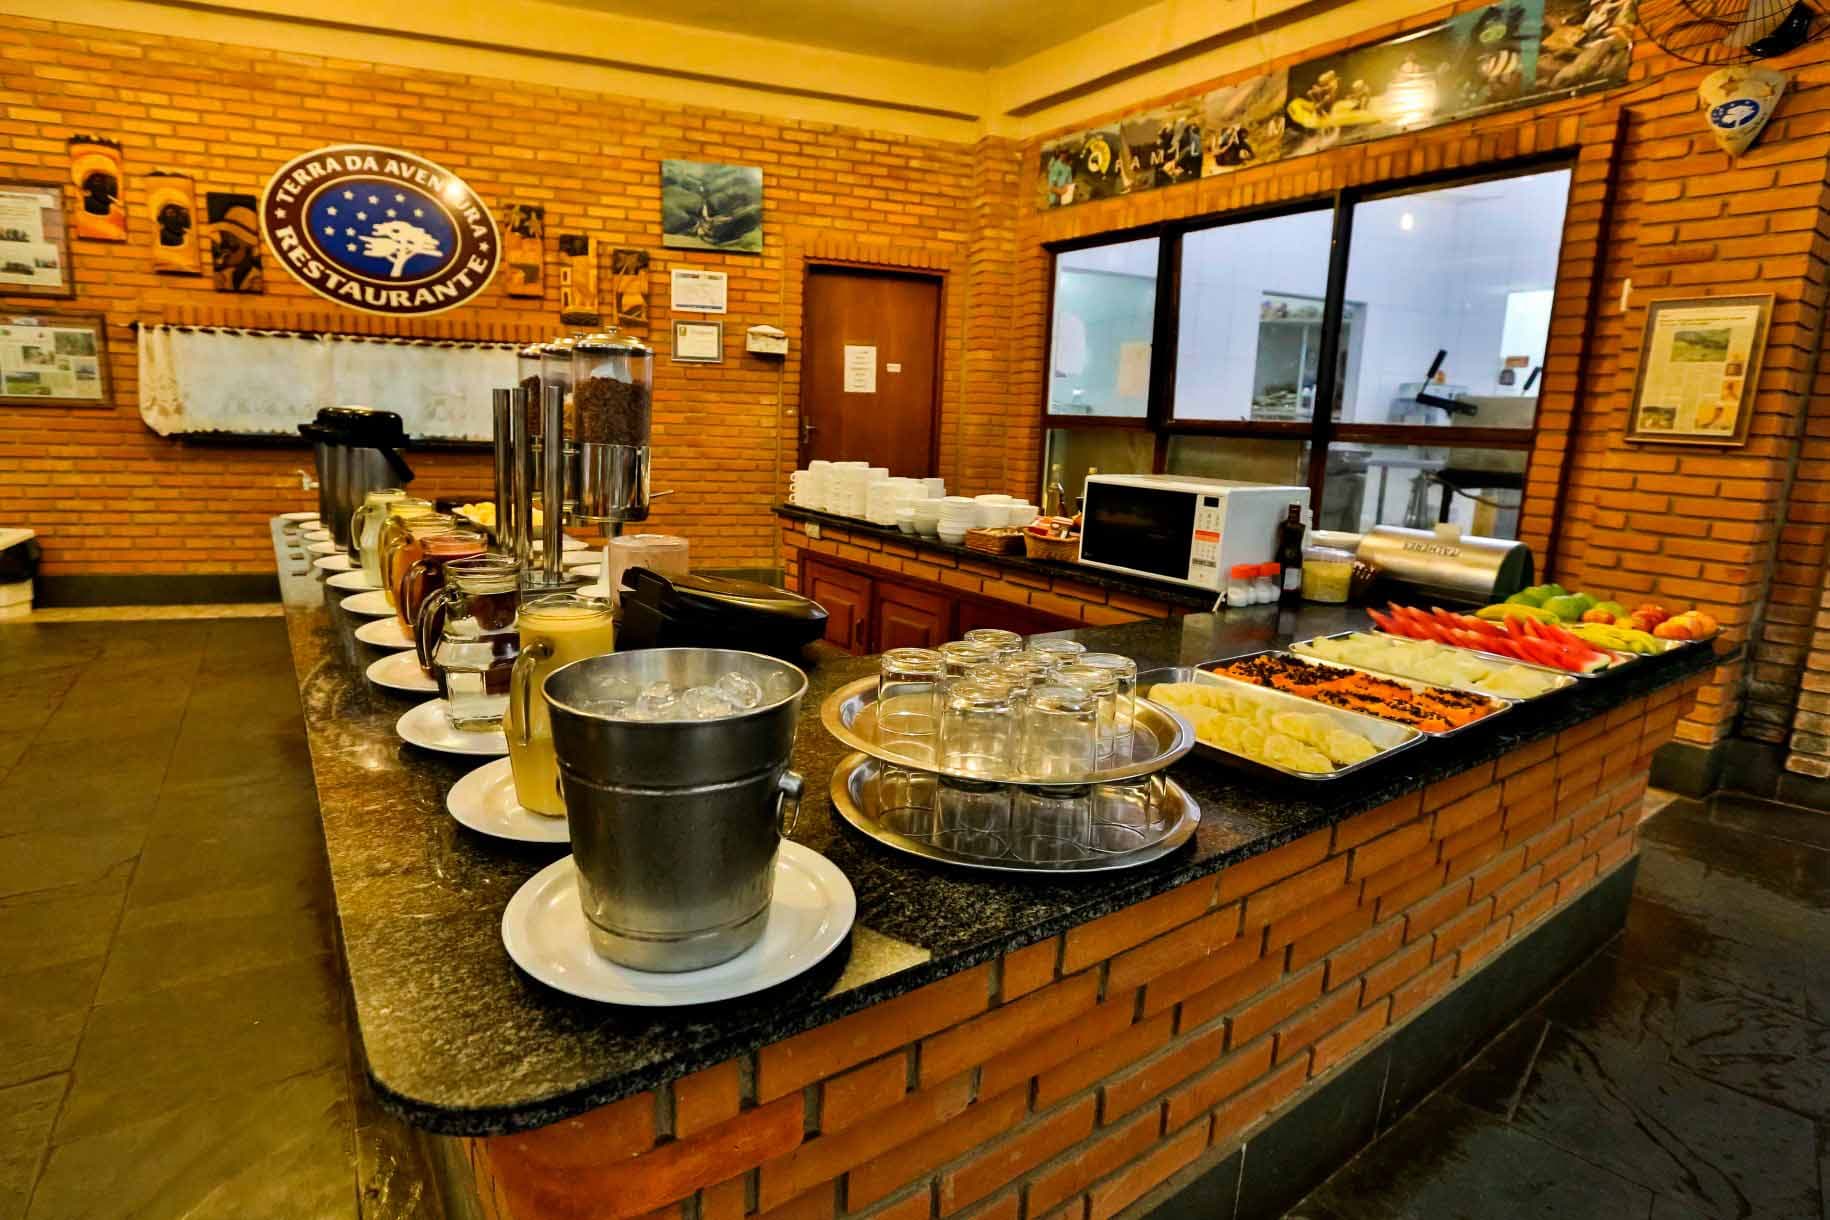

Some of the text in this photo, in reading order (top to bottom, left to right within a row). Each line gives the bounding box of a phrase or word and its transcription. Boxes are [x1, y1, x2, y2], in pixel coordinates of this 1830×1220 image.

[276, 155, 489, 238] TERRA DA AVENURA
[275, 224, 489, 308] RESTAURANTE
